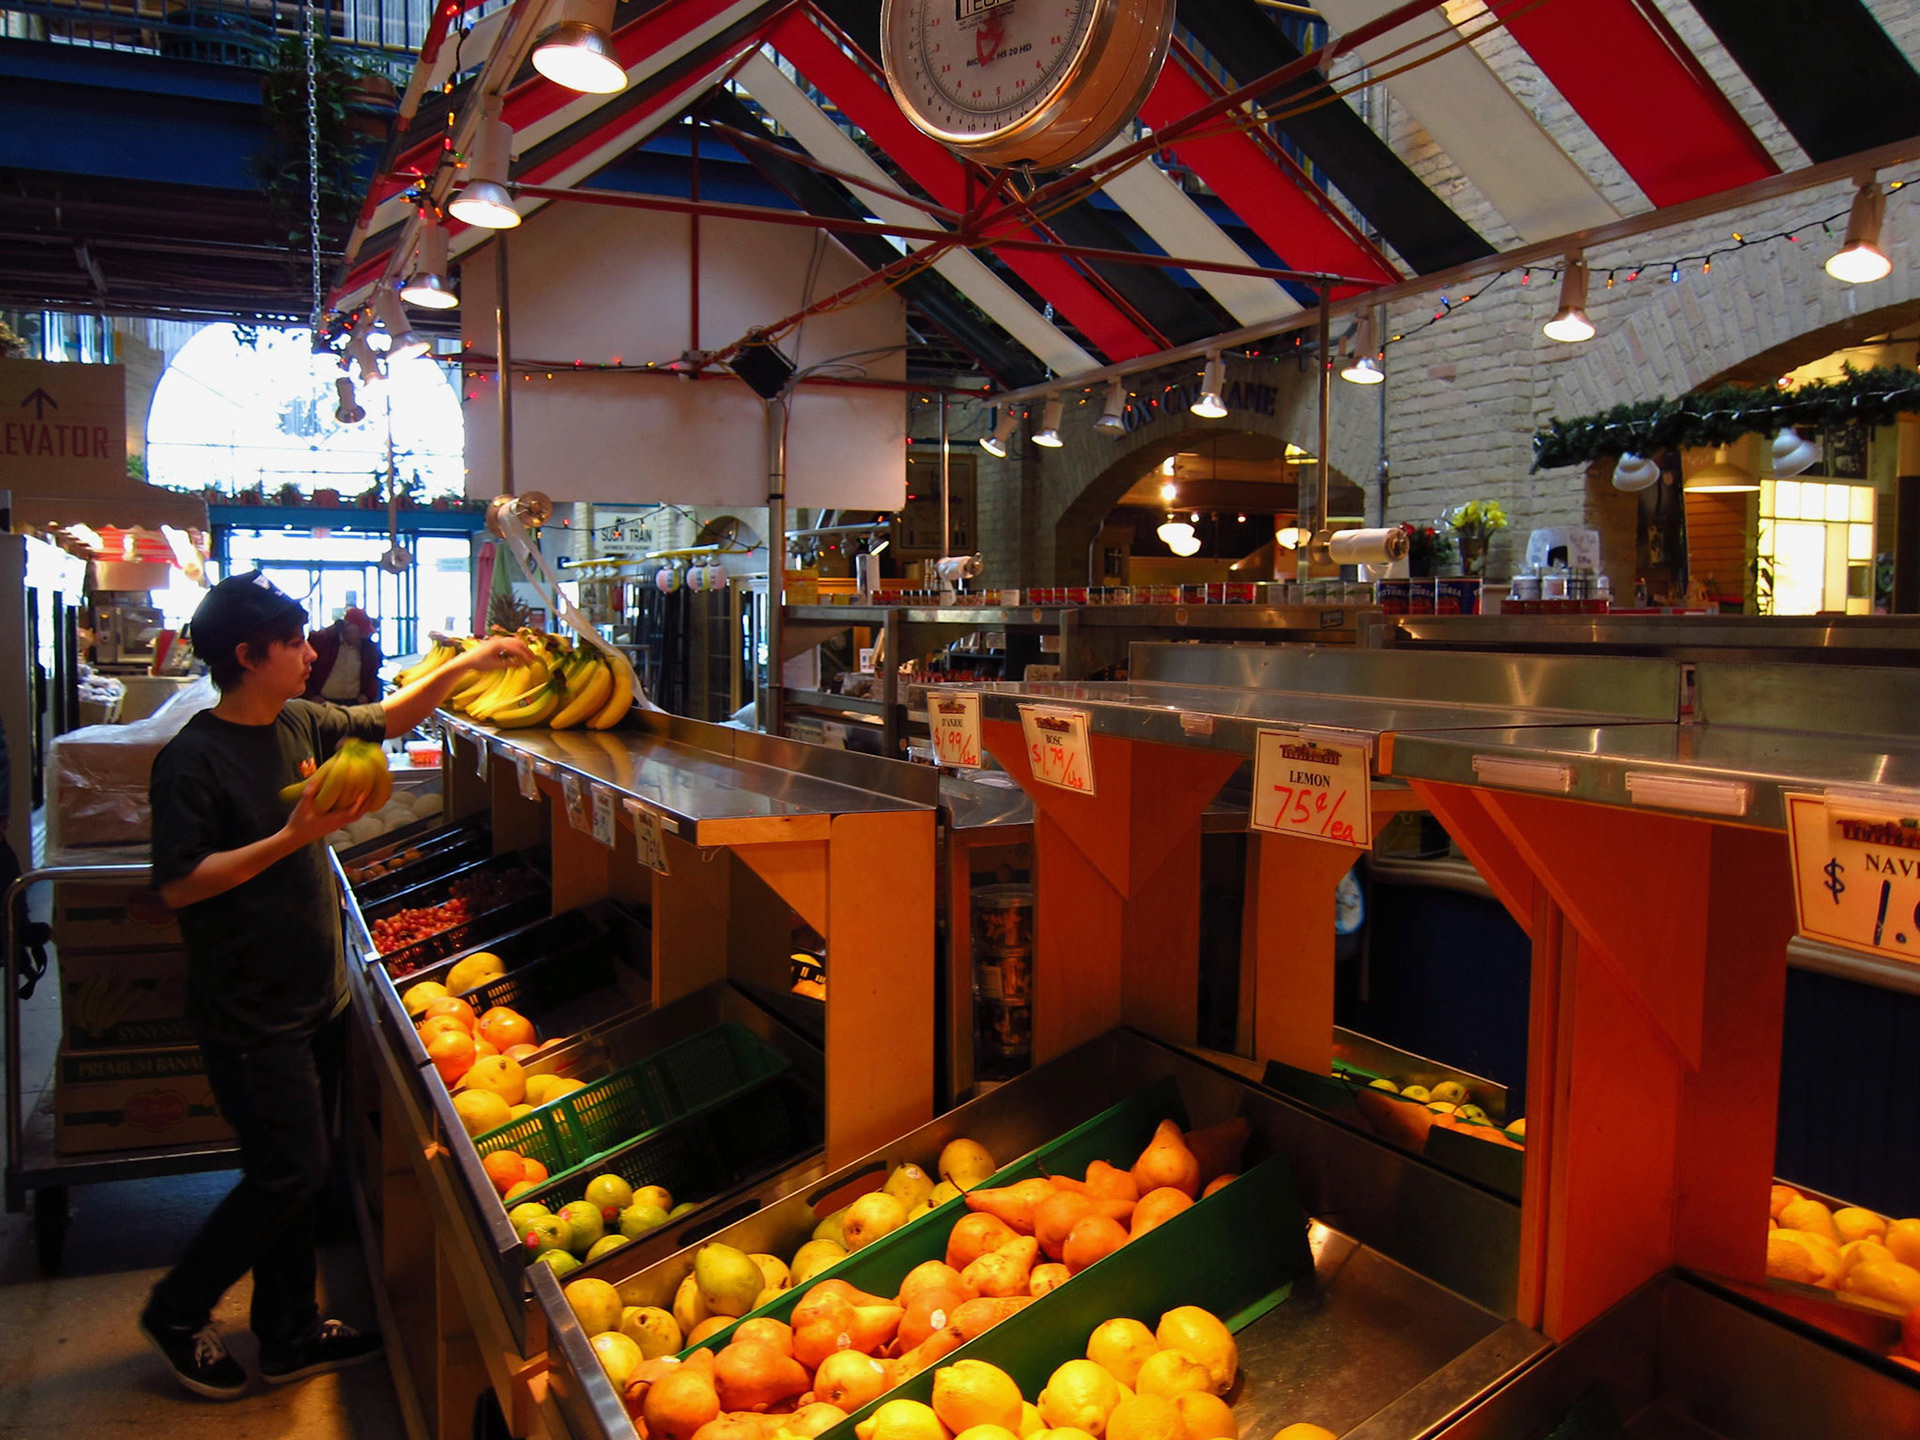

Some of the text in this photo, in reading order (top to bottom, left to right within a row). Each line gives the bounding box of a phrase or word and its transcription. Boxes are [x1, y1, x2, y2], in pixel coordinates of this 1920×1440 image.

[966, 43, 1032, 68] MOL HS 20 HD
[996, 86, 1001, 96] 5
[967, 123, 976, 132] 10
[1221, 381, 1278, 416] ANE
[0, 423, 110, 458] EVATOR
[601, 528, 652, 542] SUSI TRAIN
[1045, 734, 1064, 746] BOSC
[1289, 770, 1331, 788] LEMON
[78, 1058, 154, 1078] PREMIUM
